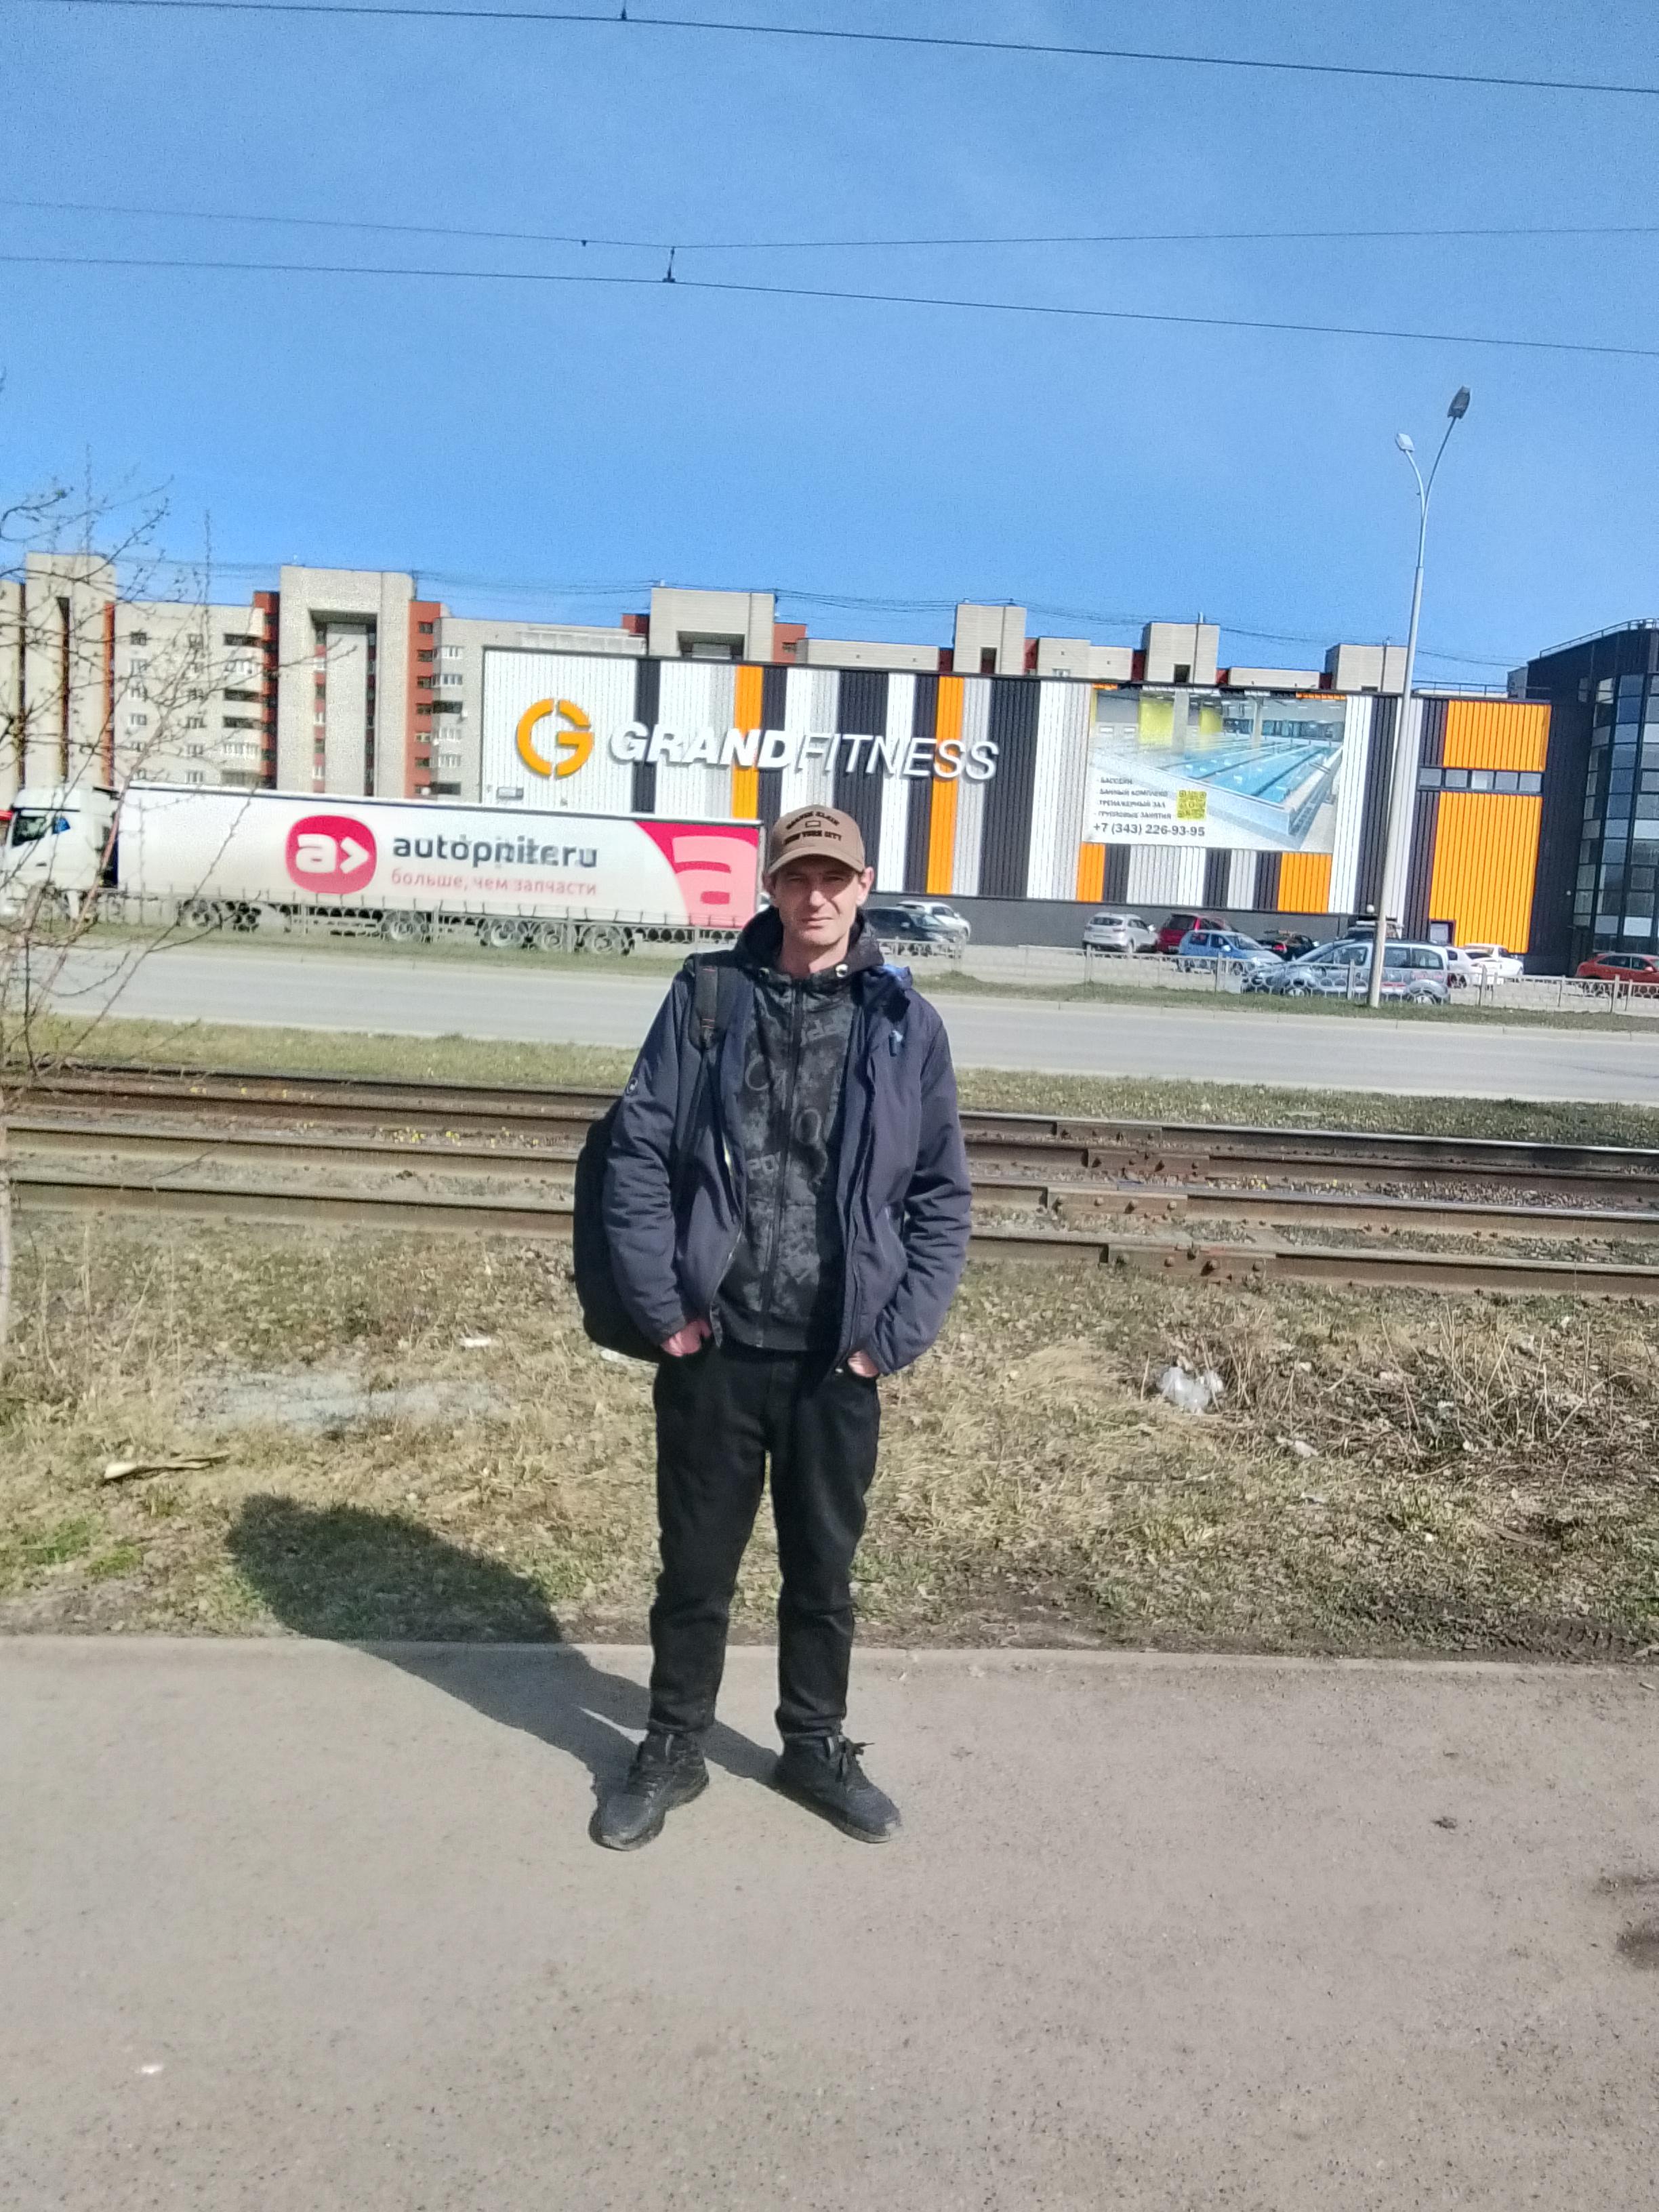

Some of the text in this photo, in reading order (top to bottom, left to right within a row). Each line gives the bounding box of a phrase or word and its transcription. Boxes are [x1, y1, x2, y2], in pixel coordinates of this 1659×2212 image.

[1093, 823, 1206, 837] +7 (343) 226-93-95
[391, 867, 597, 895] больше, чем запчасти
